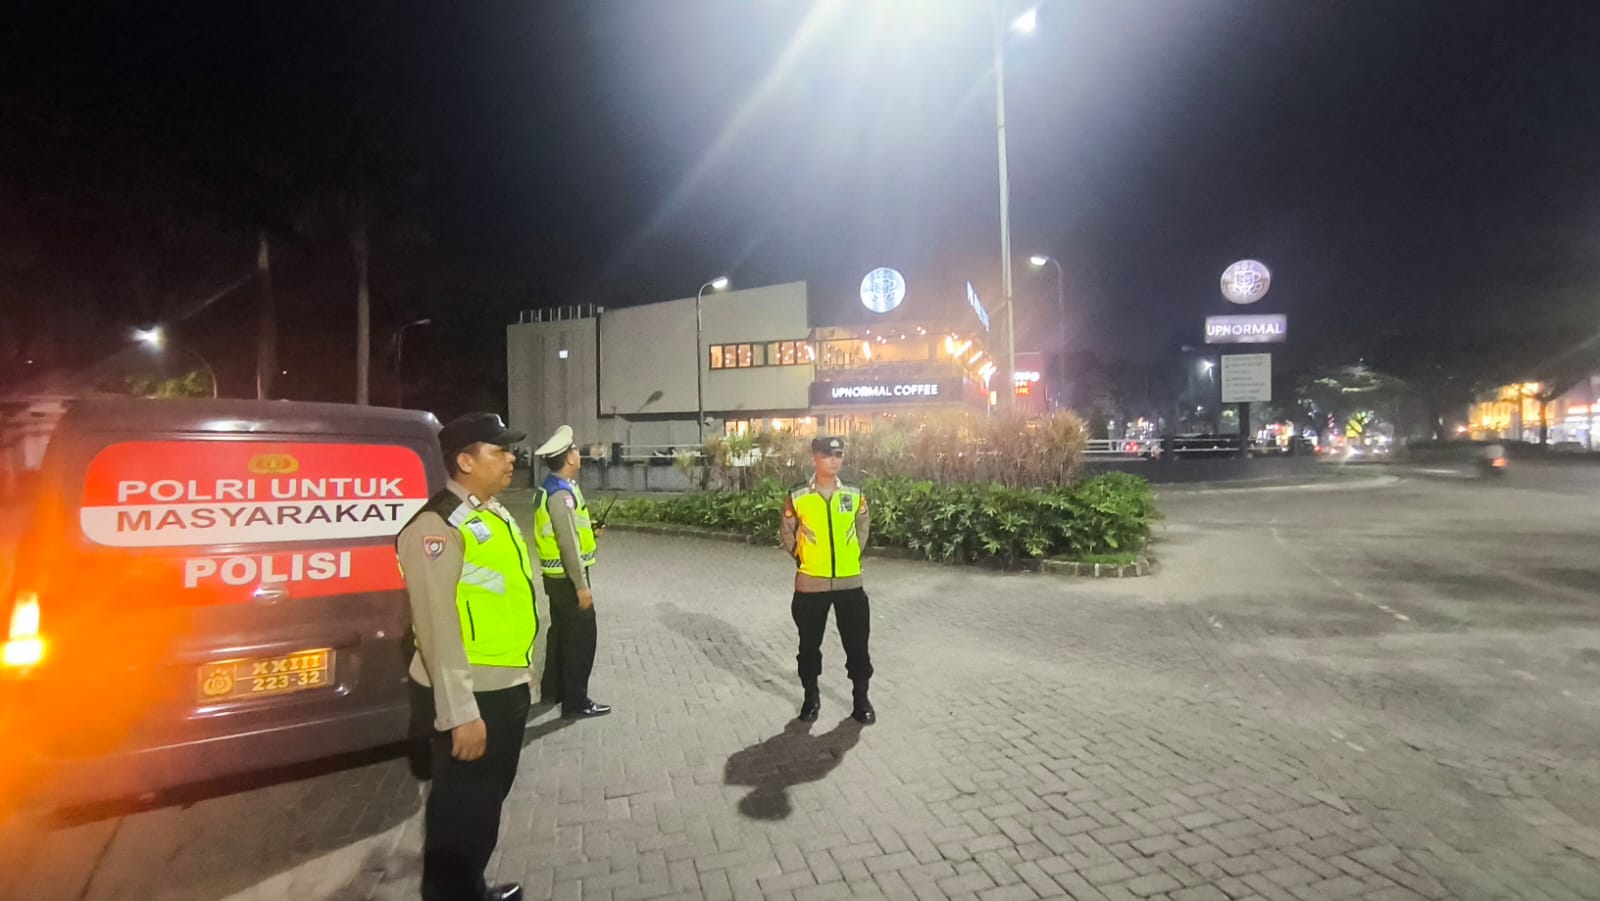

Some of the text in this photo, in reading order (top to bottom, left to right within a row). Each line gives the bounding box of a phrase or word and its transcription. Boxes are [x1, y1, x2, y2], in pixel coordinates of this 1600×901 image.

[1206, 323, 1283, 336] UPNORMAL
[831, 384, 939, 398] UPNORMAL COFFEE
[117, 477, 405, 503] POLRI UNTUK
[116, 503, 405, 533] MASYARAKAT
[184, 551, 351, 589] POLISI
[252, 655, 321, 675] XXIII
[251, 671, 320, 692] 223-32
